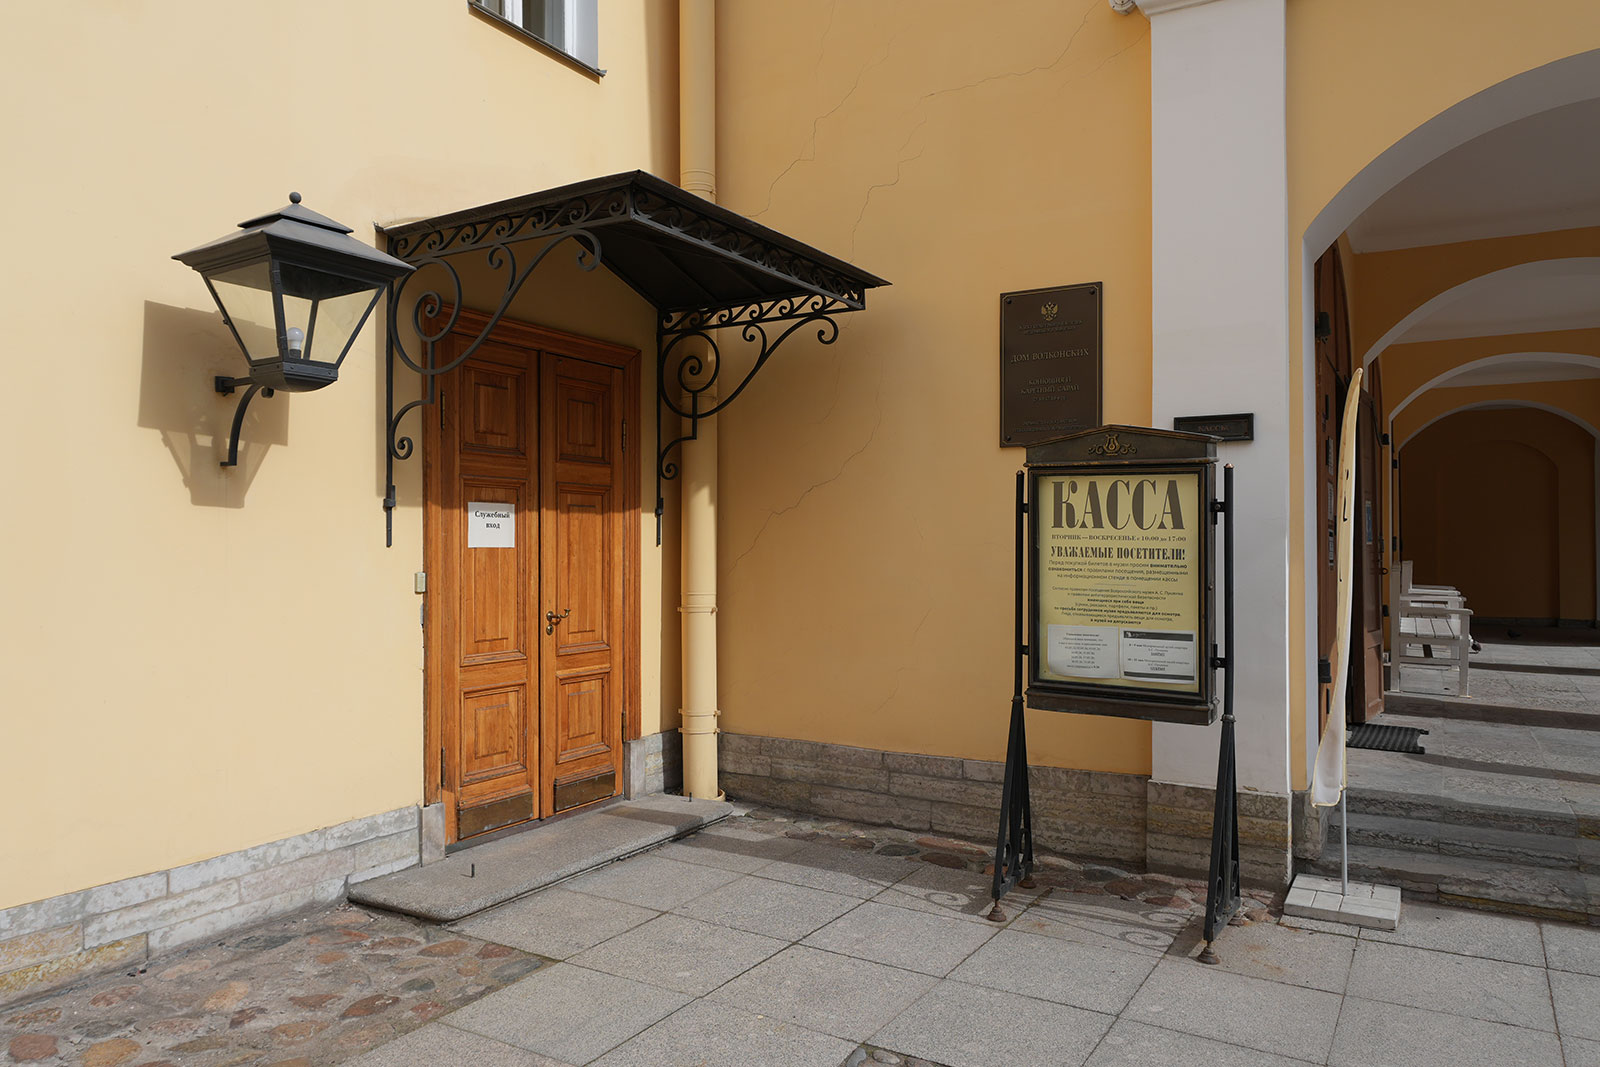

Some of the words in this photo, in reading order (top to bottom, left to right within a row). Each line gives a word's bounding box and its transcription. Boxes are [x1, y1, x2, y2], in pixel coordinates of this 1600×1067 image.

[1011, 354, 1029, 362] ДОМ
[1032, 349, 1089, 360] ВОЛКОНСКИХ
[1051, 479, 1185, 530] КАССА
[474, 510, 510, 519] Служебный
[1051, 546, 1114, 559] УВАЖАЕМЫЕ
[1117, 547, 1185, 560] ПОСЕТИТЕЛИ!
